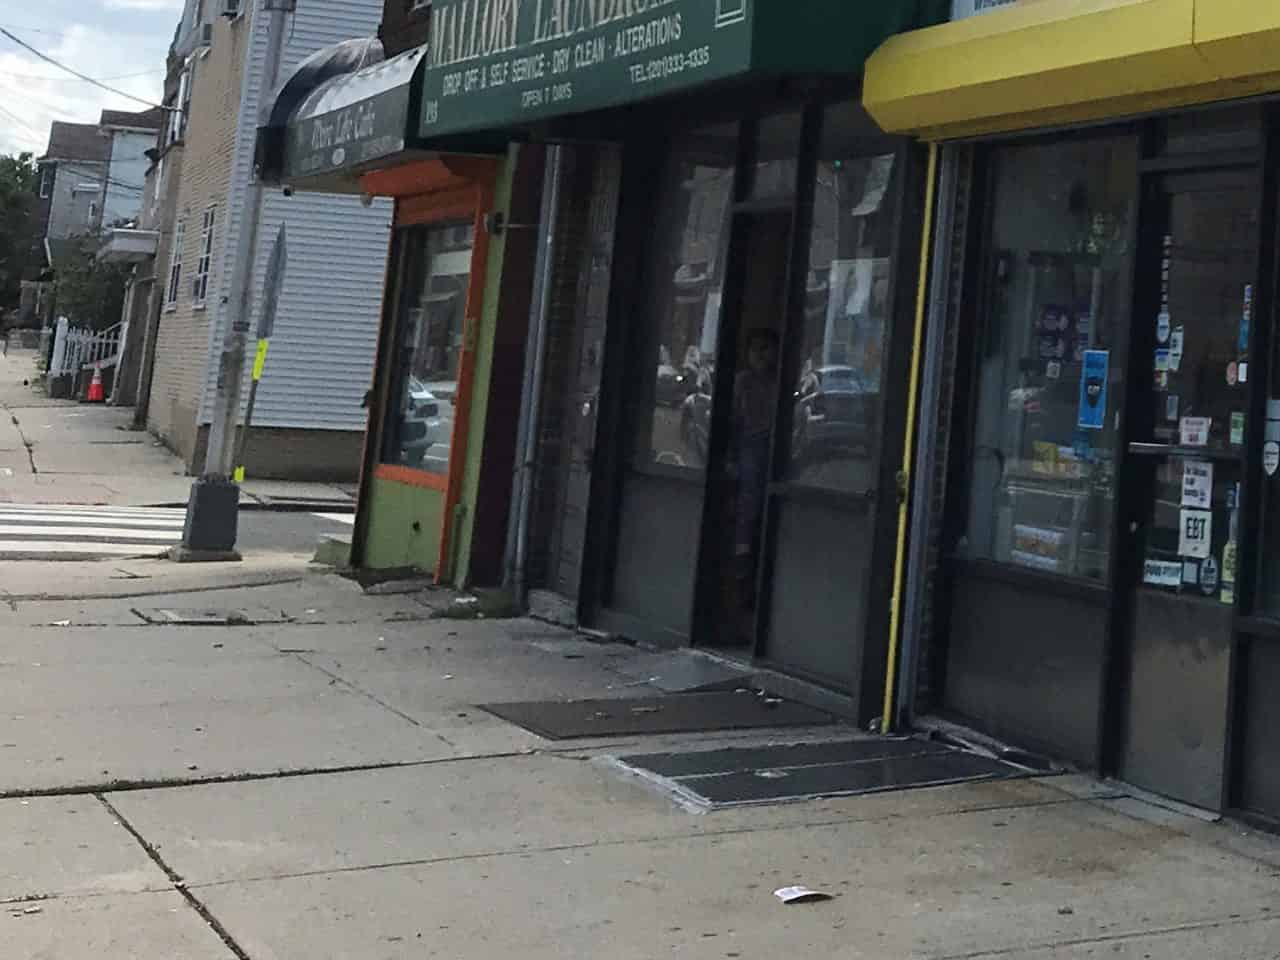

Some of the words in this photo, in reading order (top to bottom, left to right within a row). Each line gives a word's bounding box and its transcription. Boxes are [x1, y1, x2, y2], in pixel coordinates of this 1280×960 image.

[443, 71, 461, 96] DROP
[464, 67, 479, 92] OFF
[490, 61, 509, 87] SELF
[512, 52, 545, 82] SERVICE
[552, 46, 570, 74] DRY
[575, 36, 606, 68] CLEAN
[614, 12, 681, 57] ALTERATIONS
[521, 89, 543, 109] OPEN
[552, 82, 572, 102] DAYS
[1186, 516, 1206, 540] EBT
